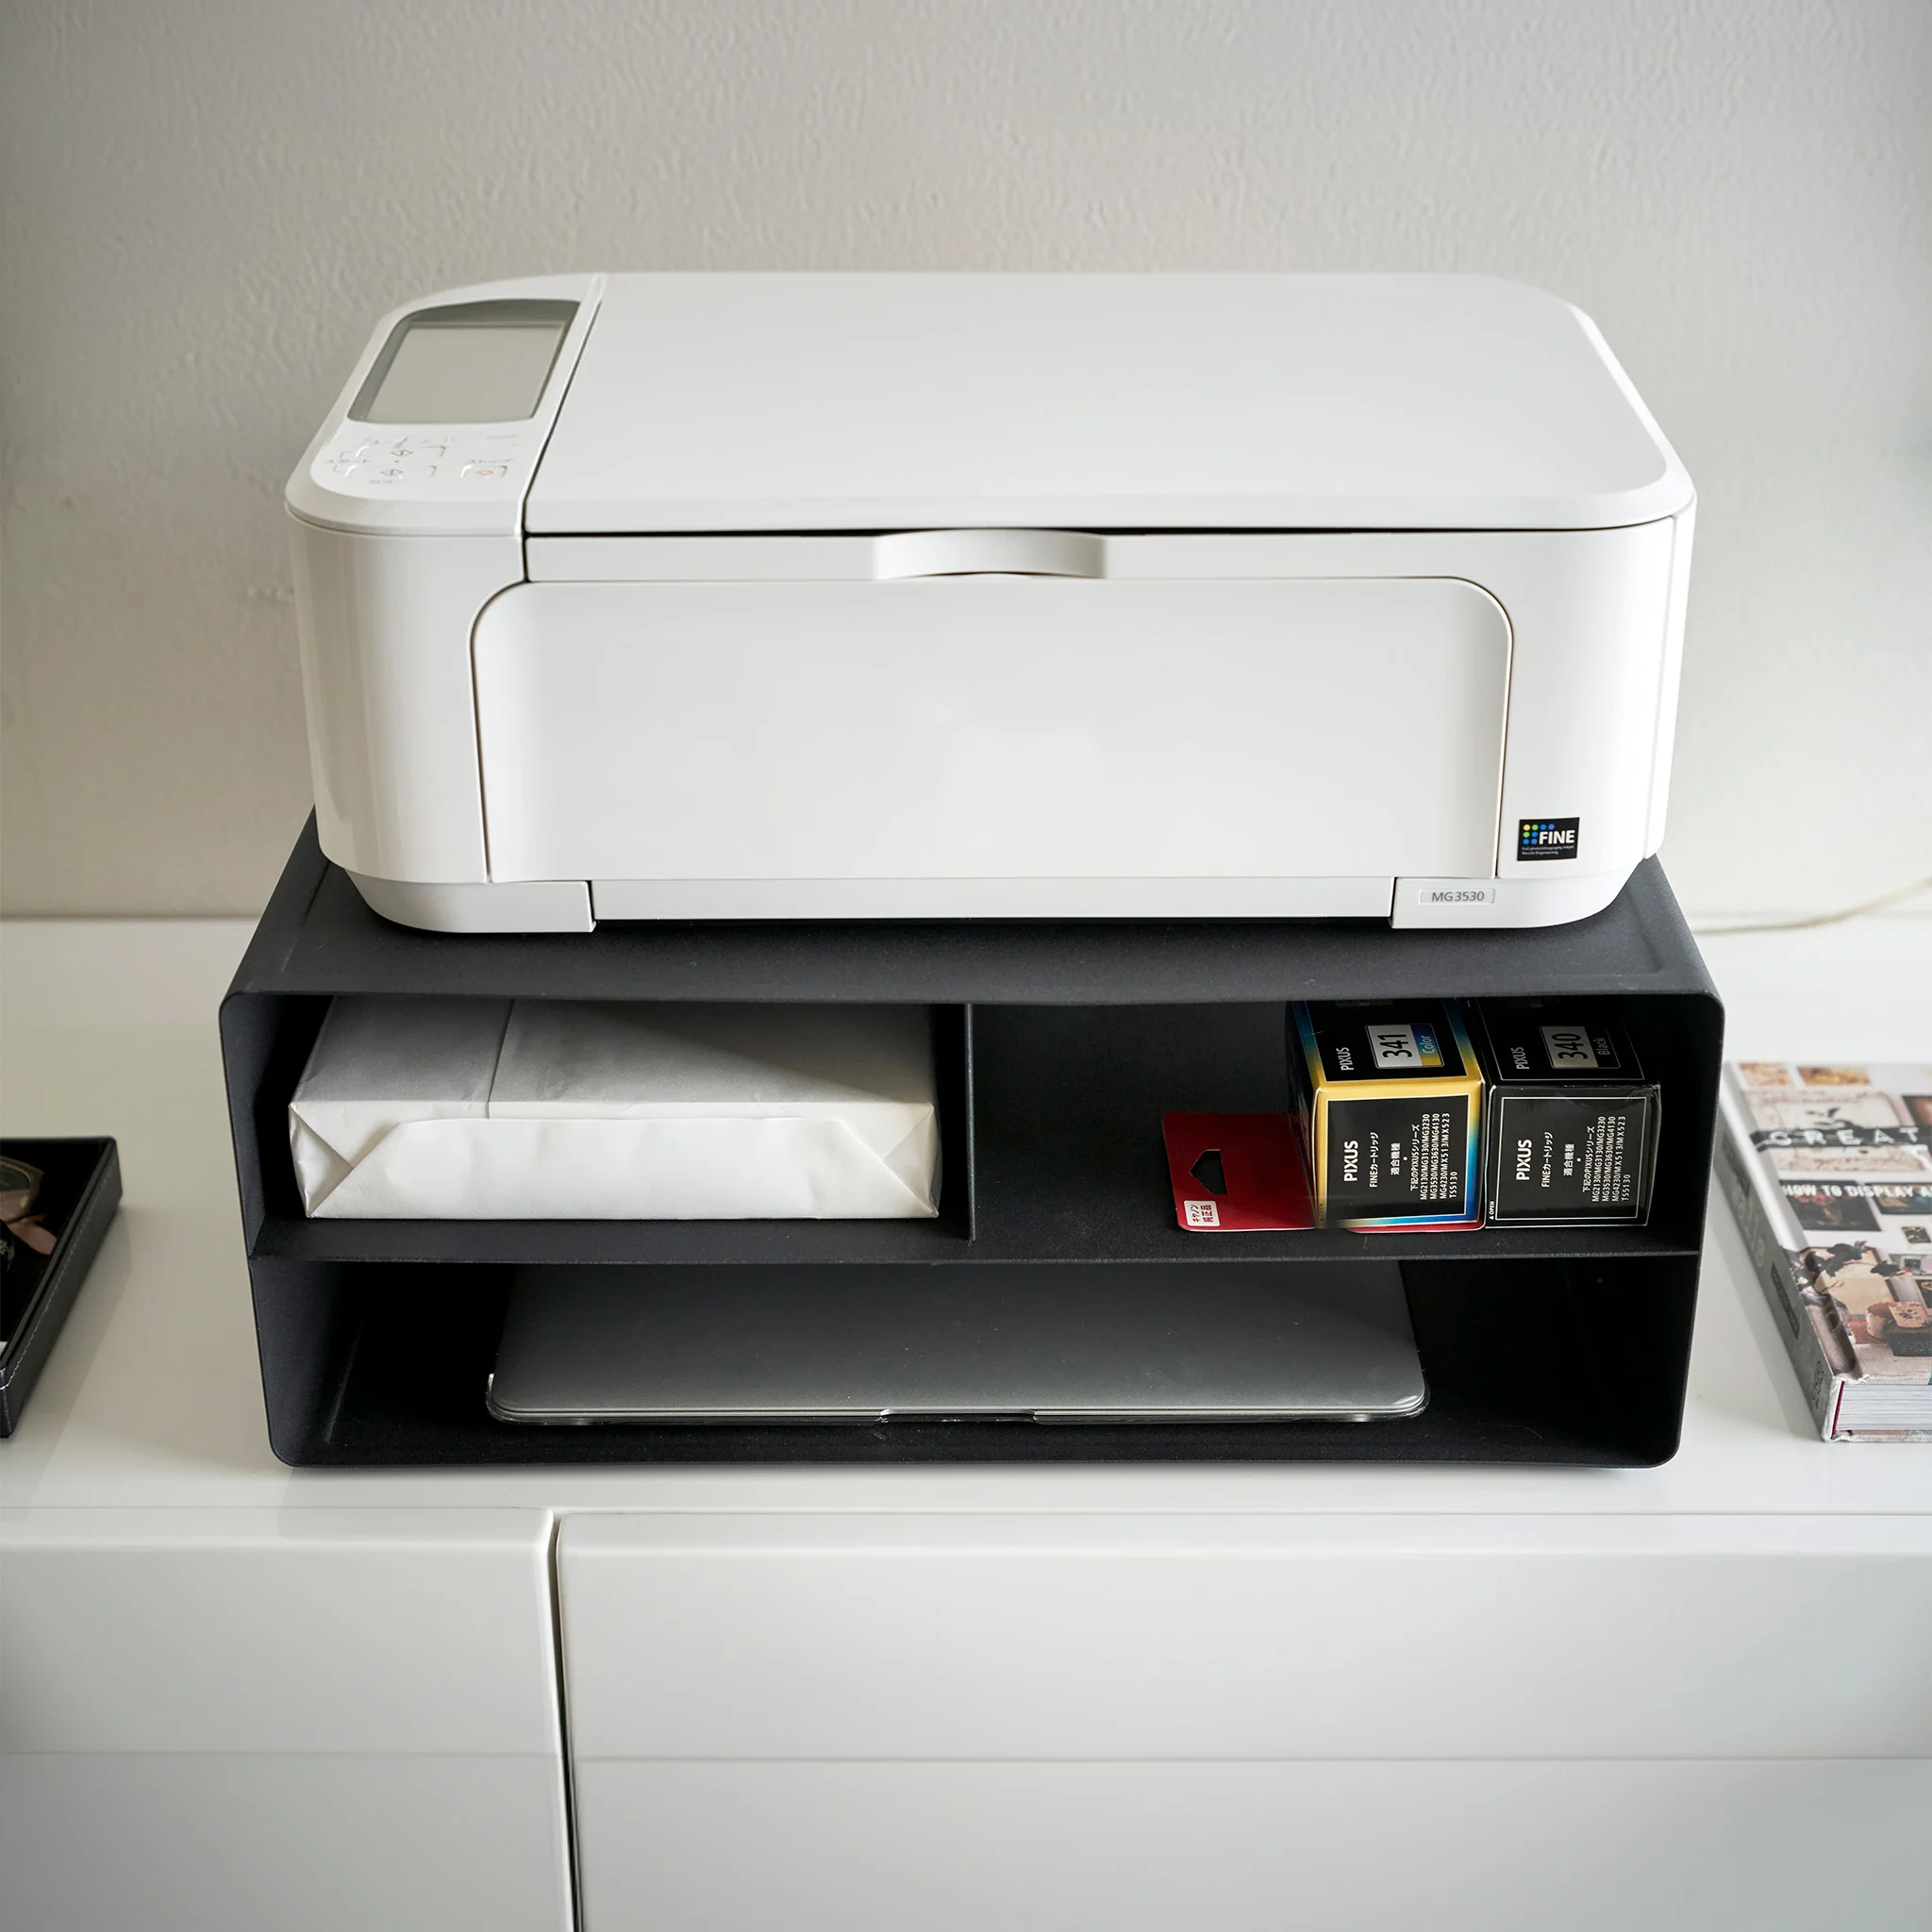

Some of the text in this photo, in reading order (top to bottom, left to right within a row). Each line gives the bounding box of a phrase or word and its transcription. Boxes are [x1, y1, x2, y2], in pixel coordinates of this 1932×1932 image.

[1539, 830, 1575, 844] FINE
[1377, 1034, 1412, 1058] 341
[1420, 1035, 1436, 1054] Color
[1510, 1046, 1530, 1070] PIXUS
[1551, 1033, 1589, 1059] 340
[1592, 1038, 1611, 1056] Black
[1336, 1046, 1355, 1071] PIXUS
[1770, 1127, 1919, 1145] GREAT
[1343, 1140, 1359, 1182] PIXUS
[1369, 1132, 1379, 1188] FINEカートリッジ
[1420, 1113, 1430, 1200] MG2130/MG3130/MG3230
[1430, 1113, 1441, 1200] MG3530/MG3630/MG4130
[1516, 1139, 1533, 1180] PIXUS
[1541, 1132, 1553, 1188] FINEカートリッジ
[1591, 1116, 1606, 1202] MG2130/MG3130/MG3230
[1602, 1116, 1616, 1202] MG3530/MG3630/MG4130
[1449, 1171, 1458, 1198] TS5130
[1622, 1174, 1631, 1201] TS5130
[1783, 1184, 1932, 1197] HOW TO DISPLAY A
